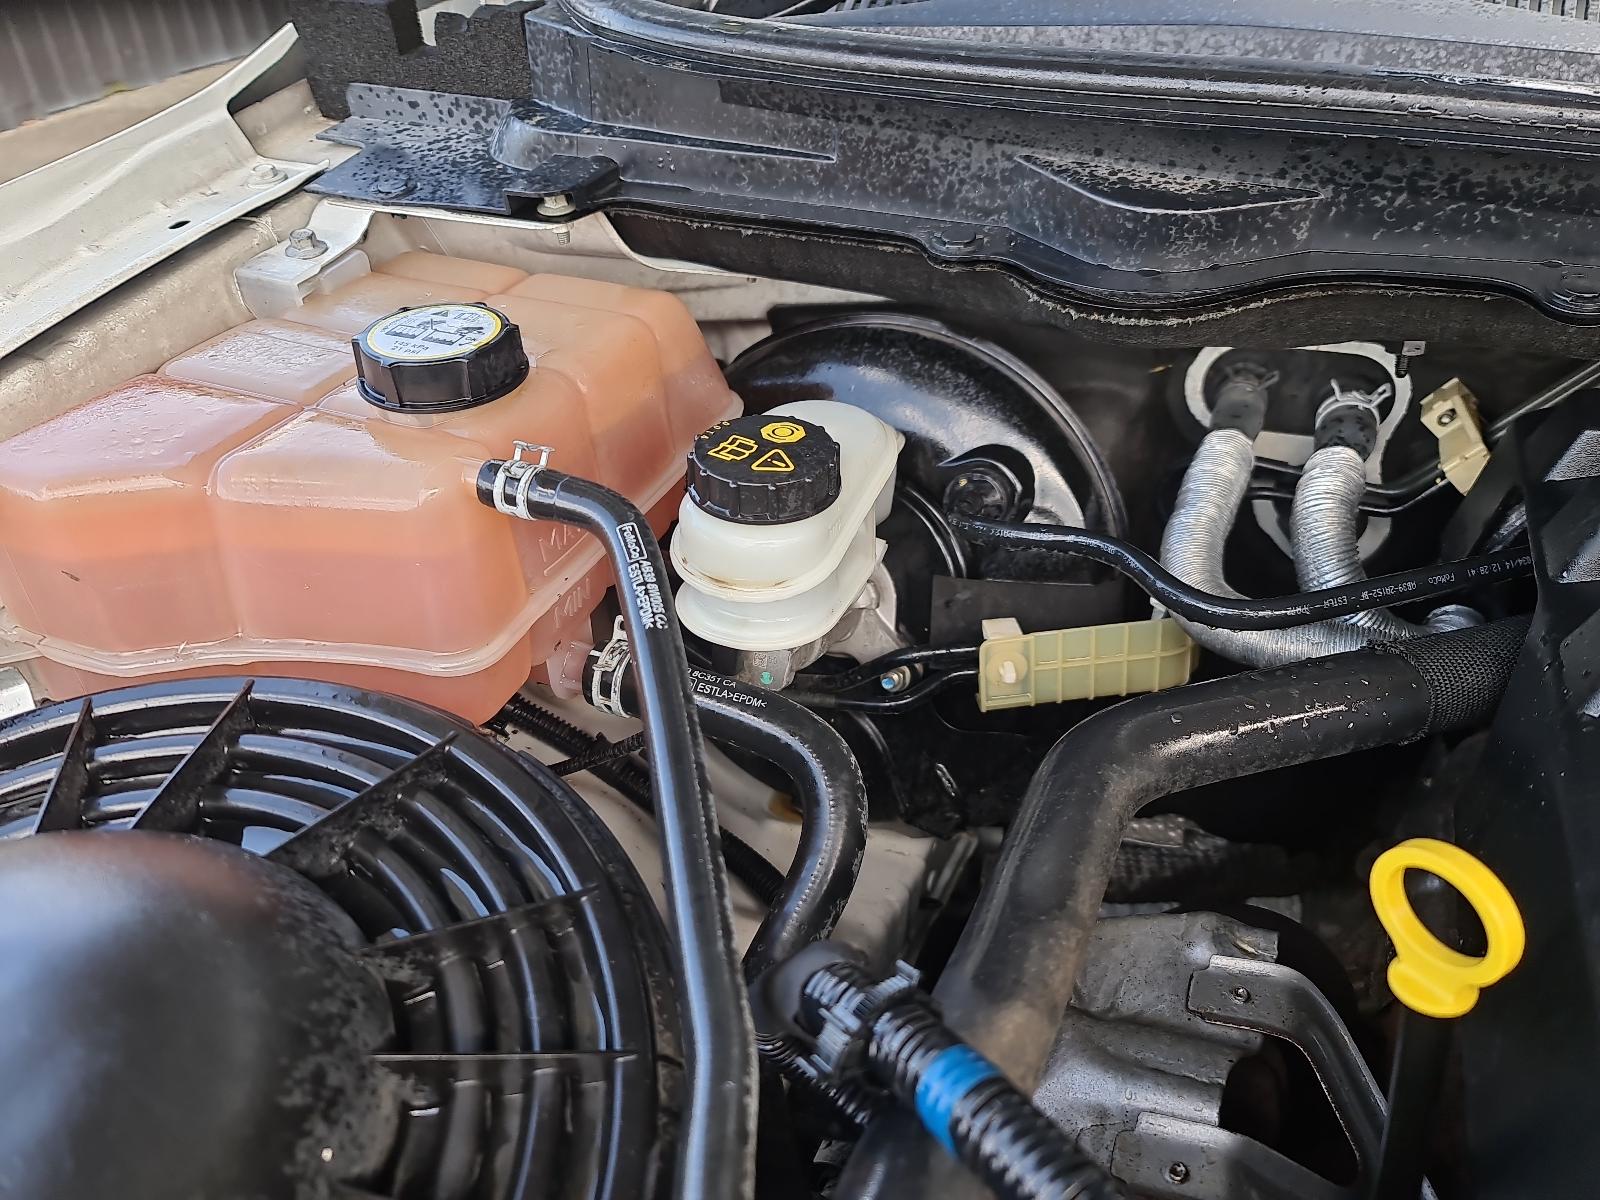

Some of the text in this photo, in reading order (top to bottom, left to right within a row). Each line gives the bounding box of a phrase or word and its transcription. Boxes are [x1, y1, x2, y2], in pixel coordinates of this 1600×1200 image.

[621, 523, 641, 561] FoMoCo
[638, 560, 657, 583] AB39
[1427, 572, 1456, 585] FoMoCo
[722, 679, 737, 689] CA
